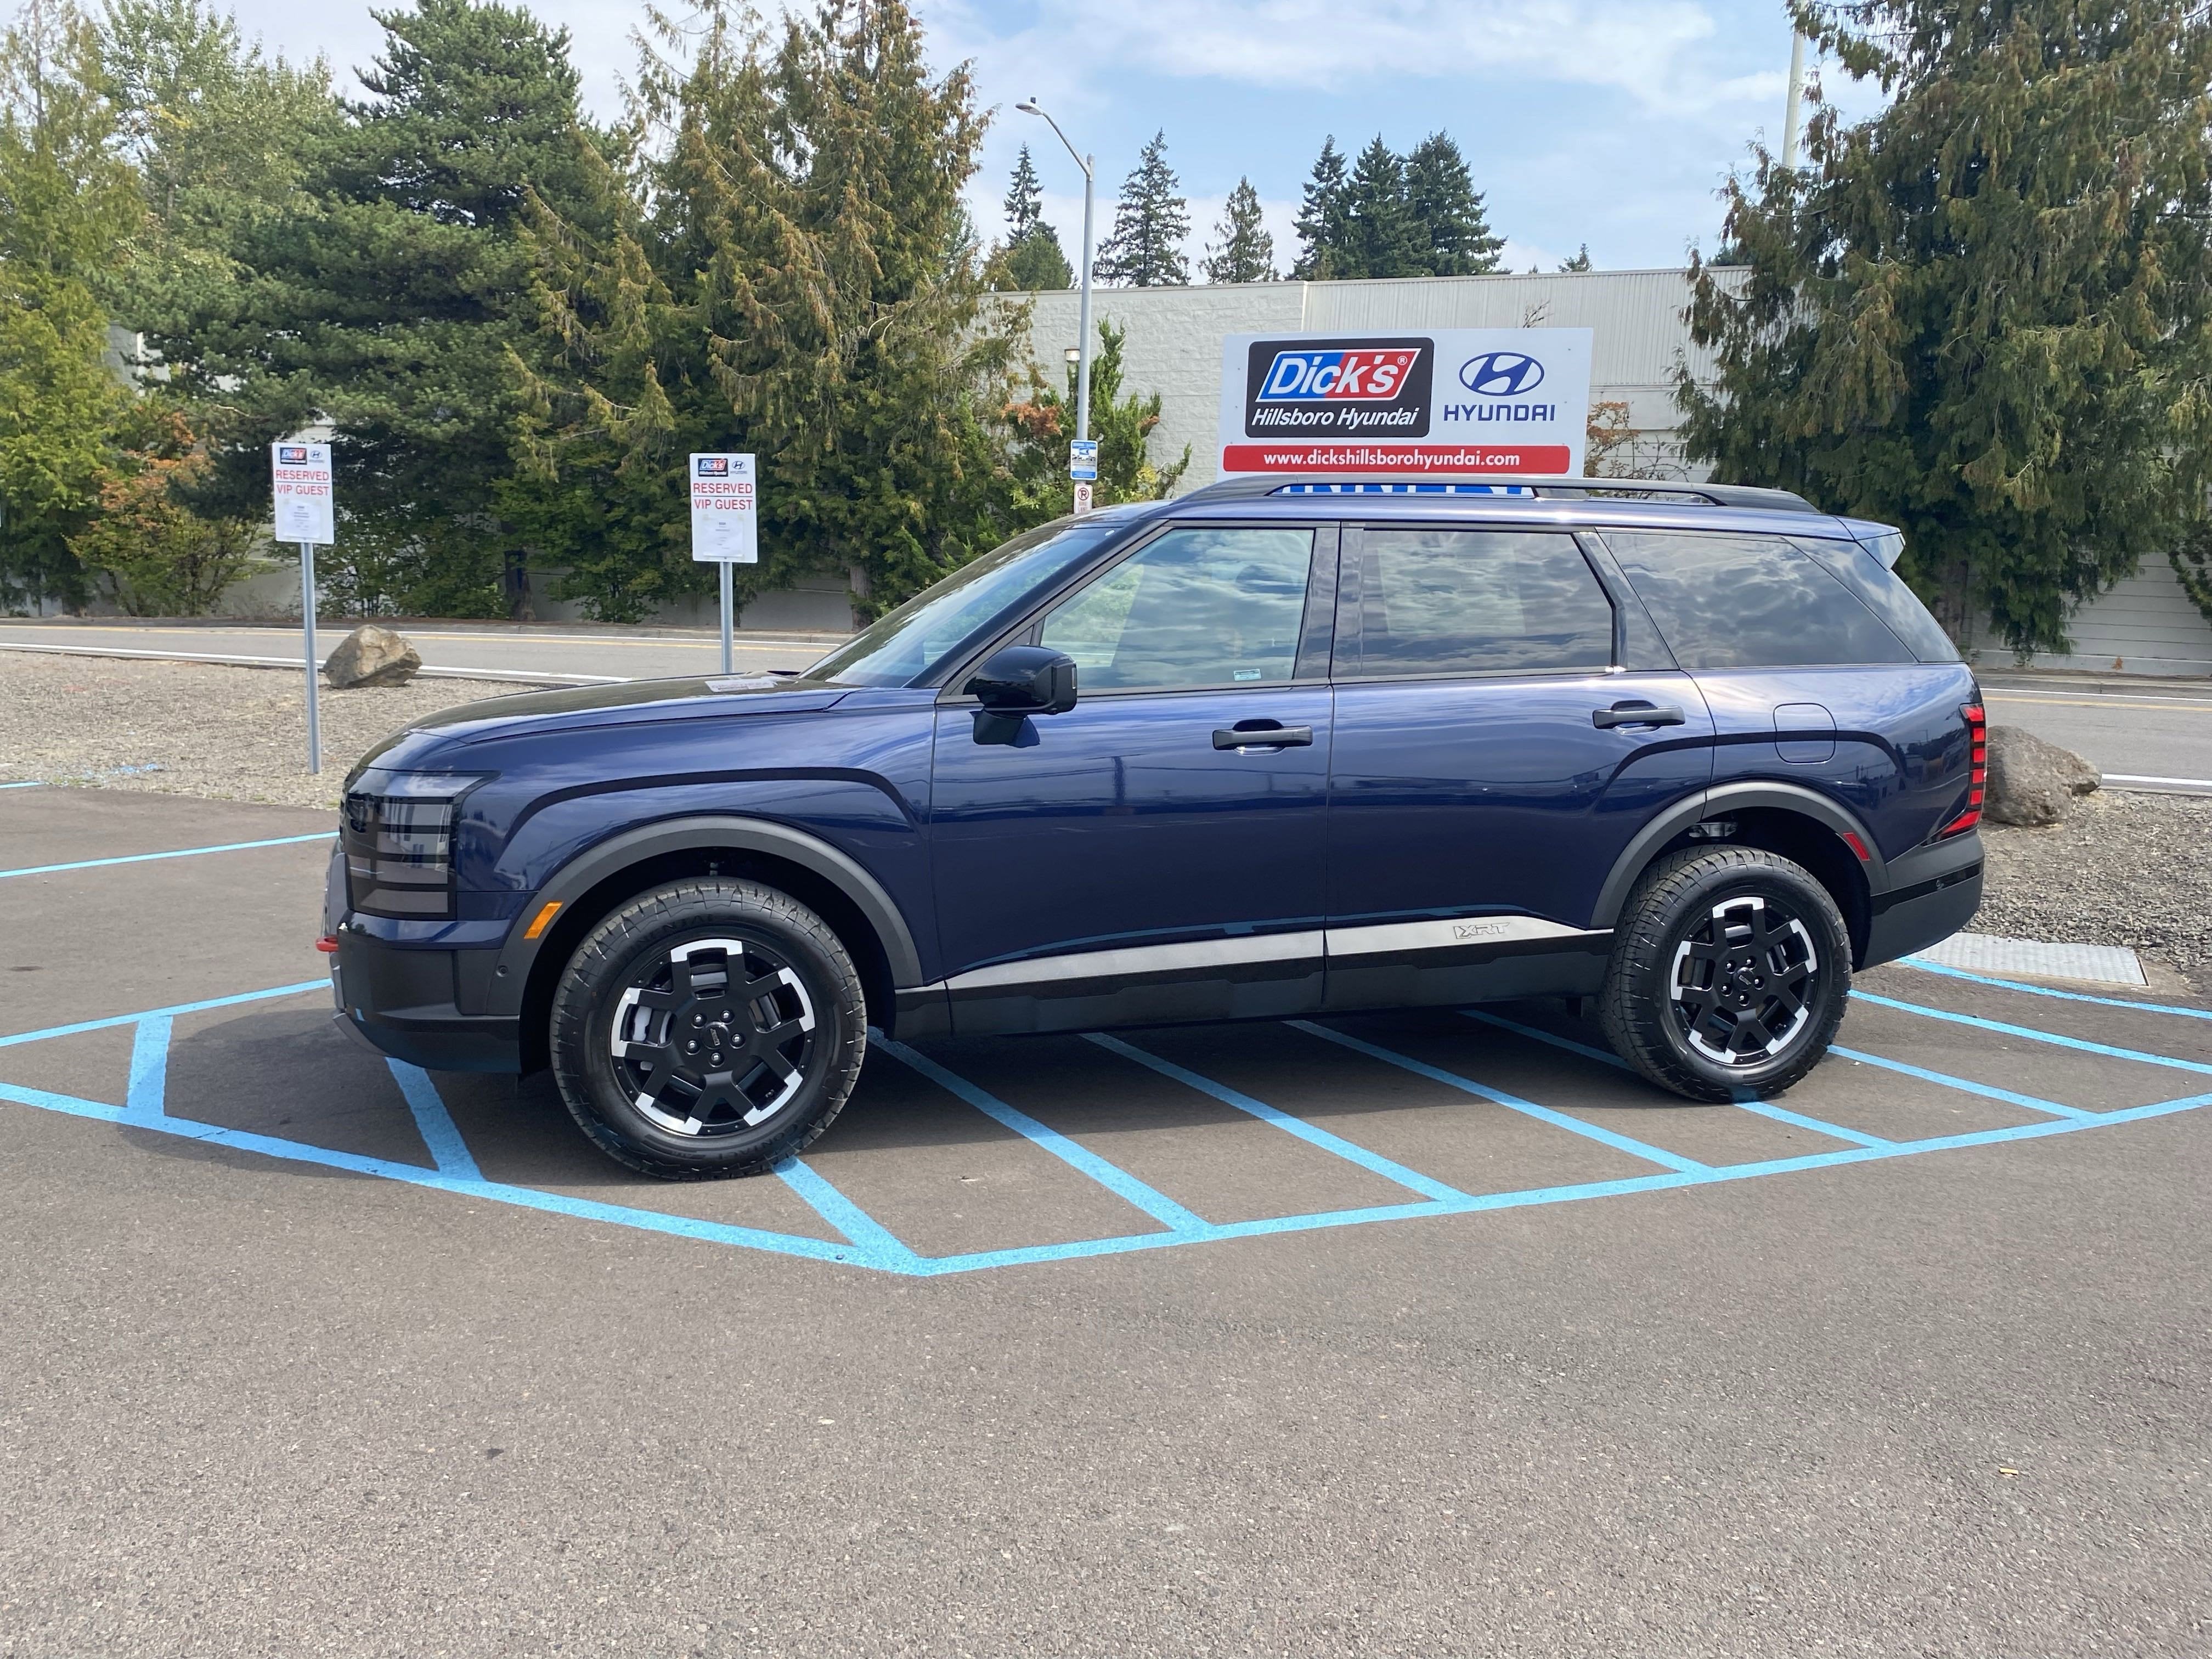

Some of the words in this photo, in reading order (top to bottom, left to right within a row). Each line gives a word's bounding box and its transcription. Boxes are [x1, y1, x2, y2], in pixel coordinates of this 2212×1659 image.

[1268, 355, 1398, 394] Dick's
[1251, 408, 1334, 426] Hillsboro
[1336, 407, 1420, 430] Hyundai
[1444, 404, 1555, 421] HYUNDAI
[1263, 449, 1520, 470] www.dickshillsborohyundai.com
[275, 470, 329, 481] RESERVED
[276, 484, 292, 494] VIP
[296, 485, 329, 496] GUEST
[693, 483, 752, 493] RESERVED
[694, 499, 712, 509] VIP
[715, 499, 753, 510] GUEST
[1453, 922, 1510, 939] XRT
